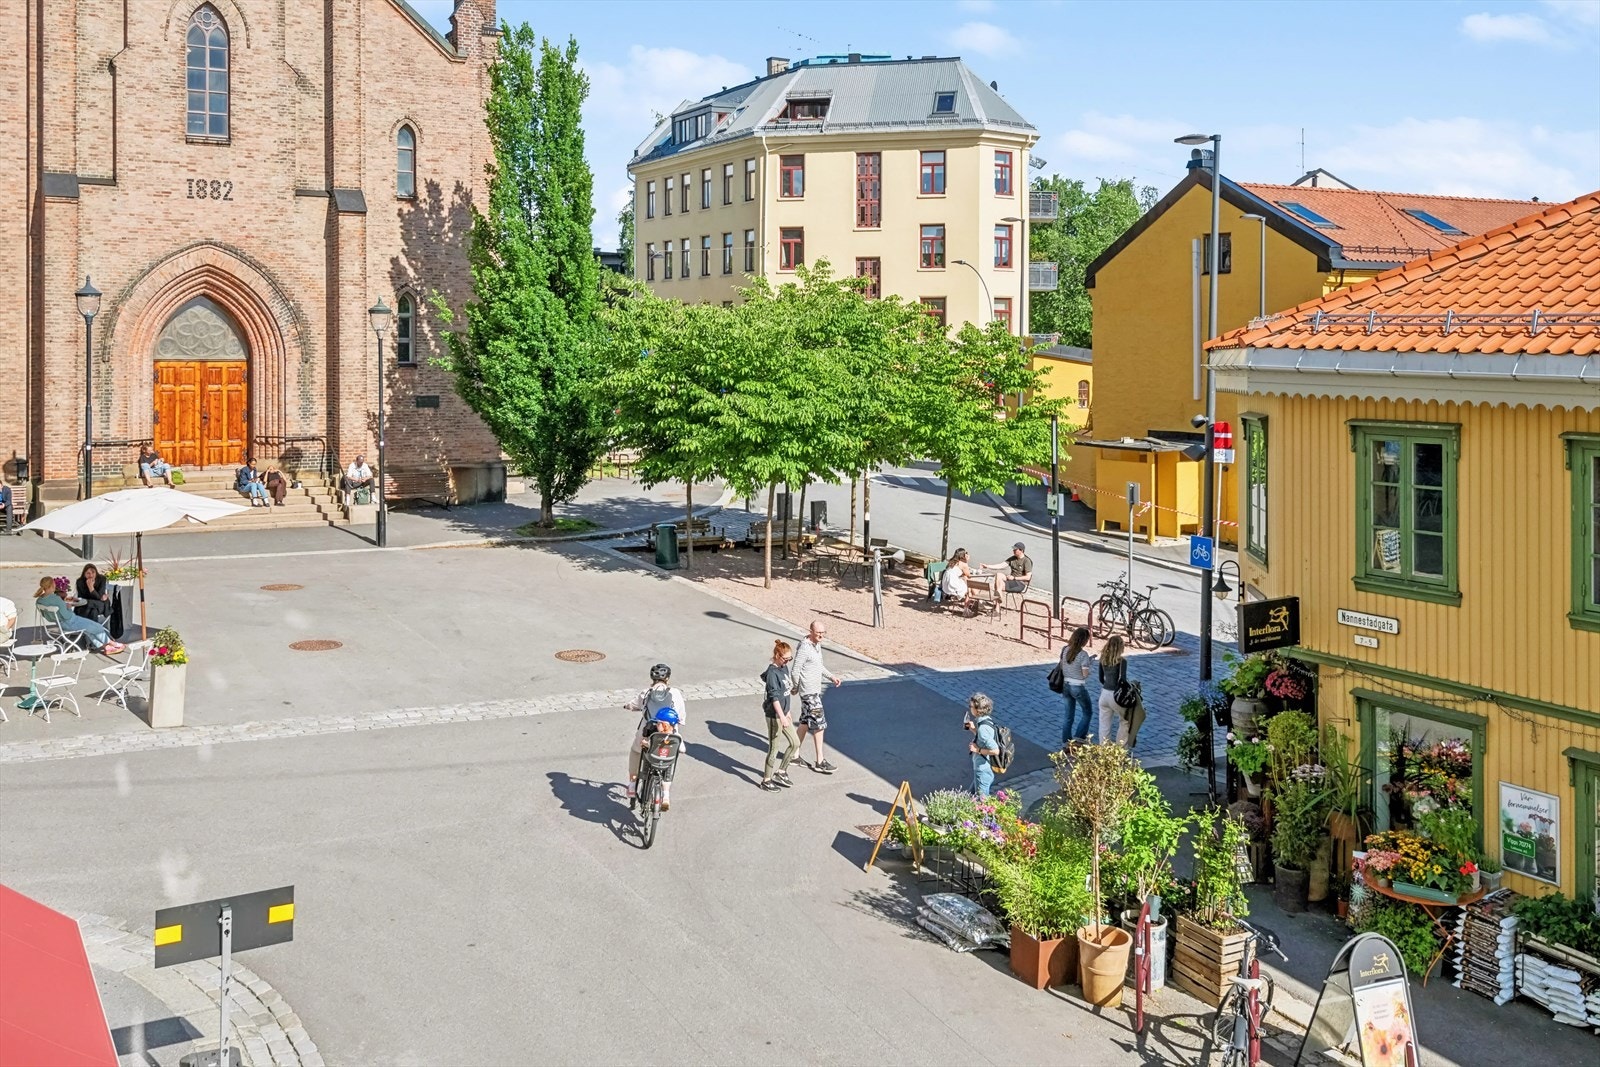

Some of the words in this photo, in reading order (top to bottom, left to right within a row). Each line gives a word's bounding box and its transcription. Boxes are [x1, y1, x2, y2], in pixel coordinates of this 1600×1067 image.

[186, 178, 234, 201] 1882
[1341, 611, 1394, 631] Nannestadgata
[1248, 624, 1281, 637] Interflora
[1359, 967, 1384, 978] Interflora
